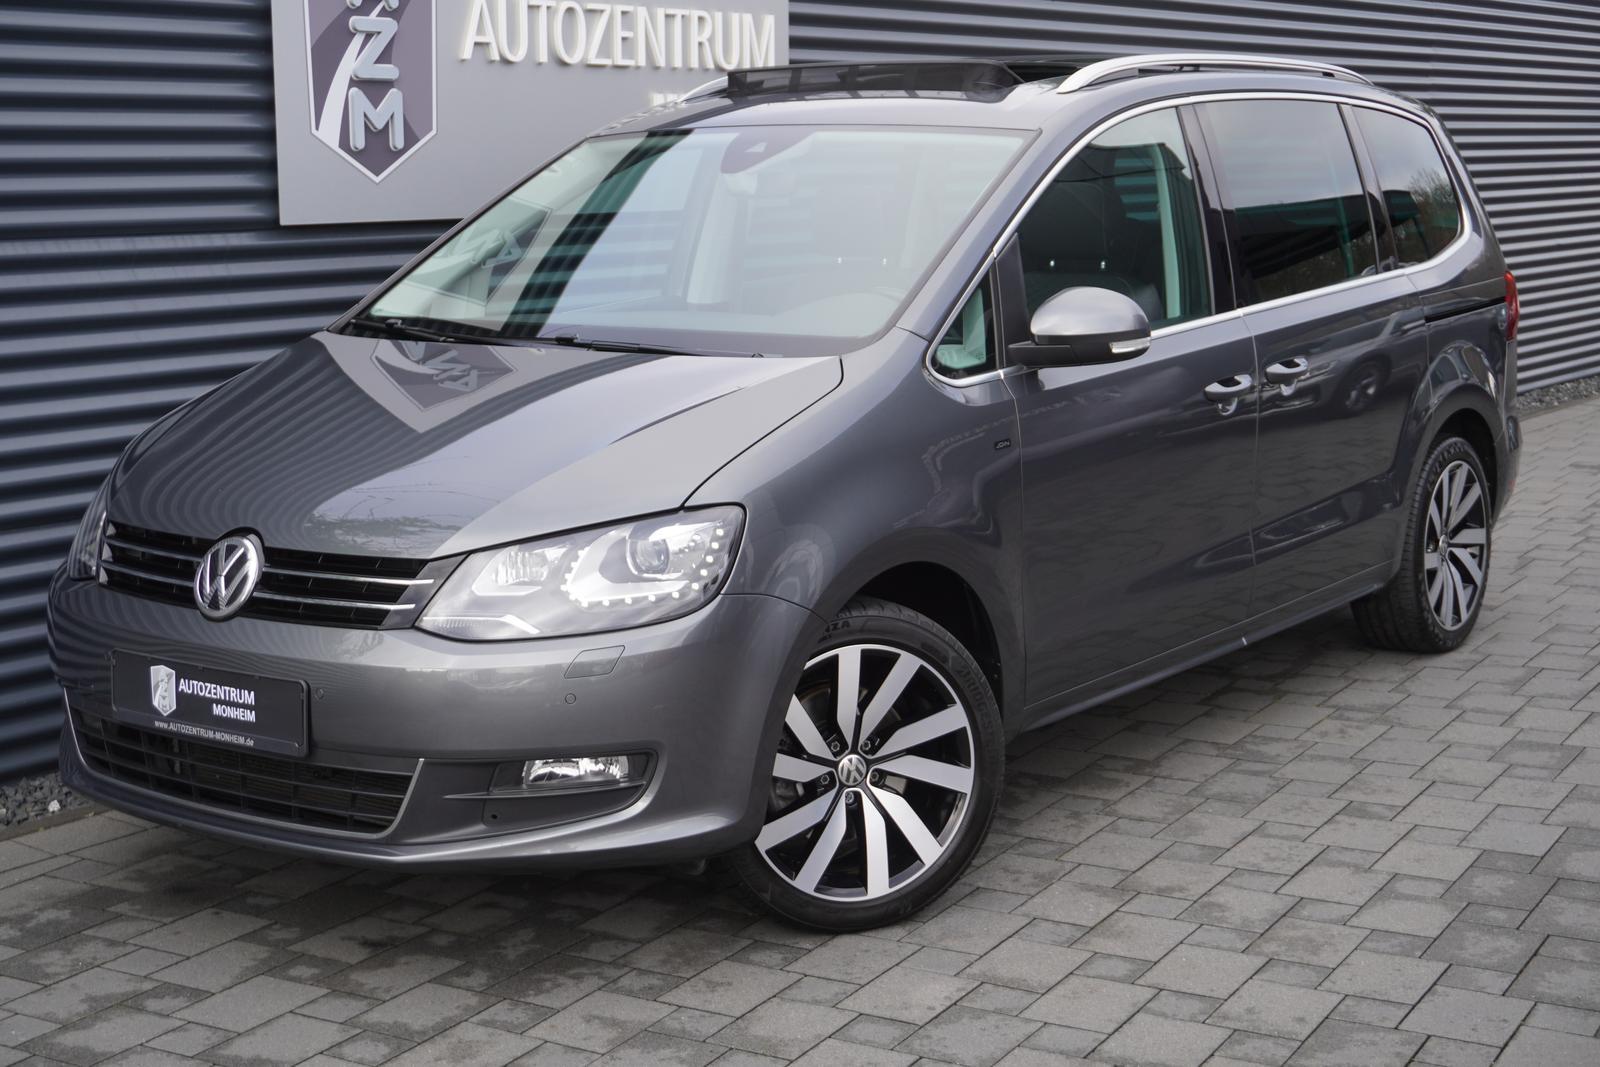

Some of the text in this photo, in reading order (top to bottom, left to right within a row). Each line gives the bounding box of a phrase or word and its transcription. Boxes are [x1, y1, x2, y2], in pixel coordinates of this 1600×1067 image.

[459, 0, 775, 71] AUTOZENTRUM
[178, 677, 255, 706] AUTOZENTRUM
[212, 703, 256, 723] MONHEIM
[154, 720, 255, 747] www.AUTOZENTRUM-MONHEIM.de
